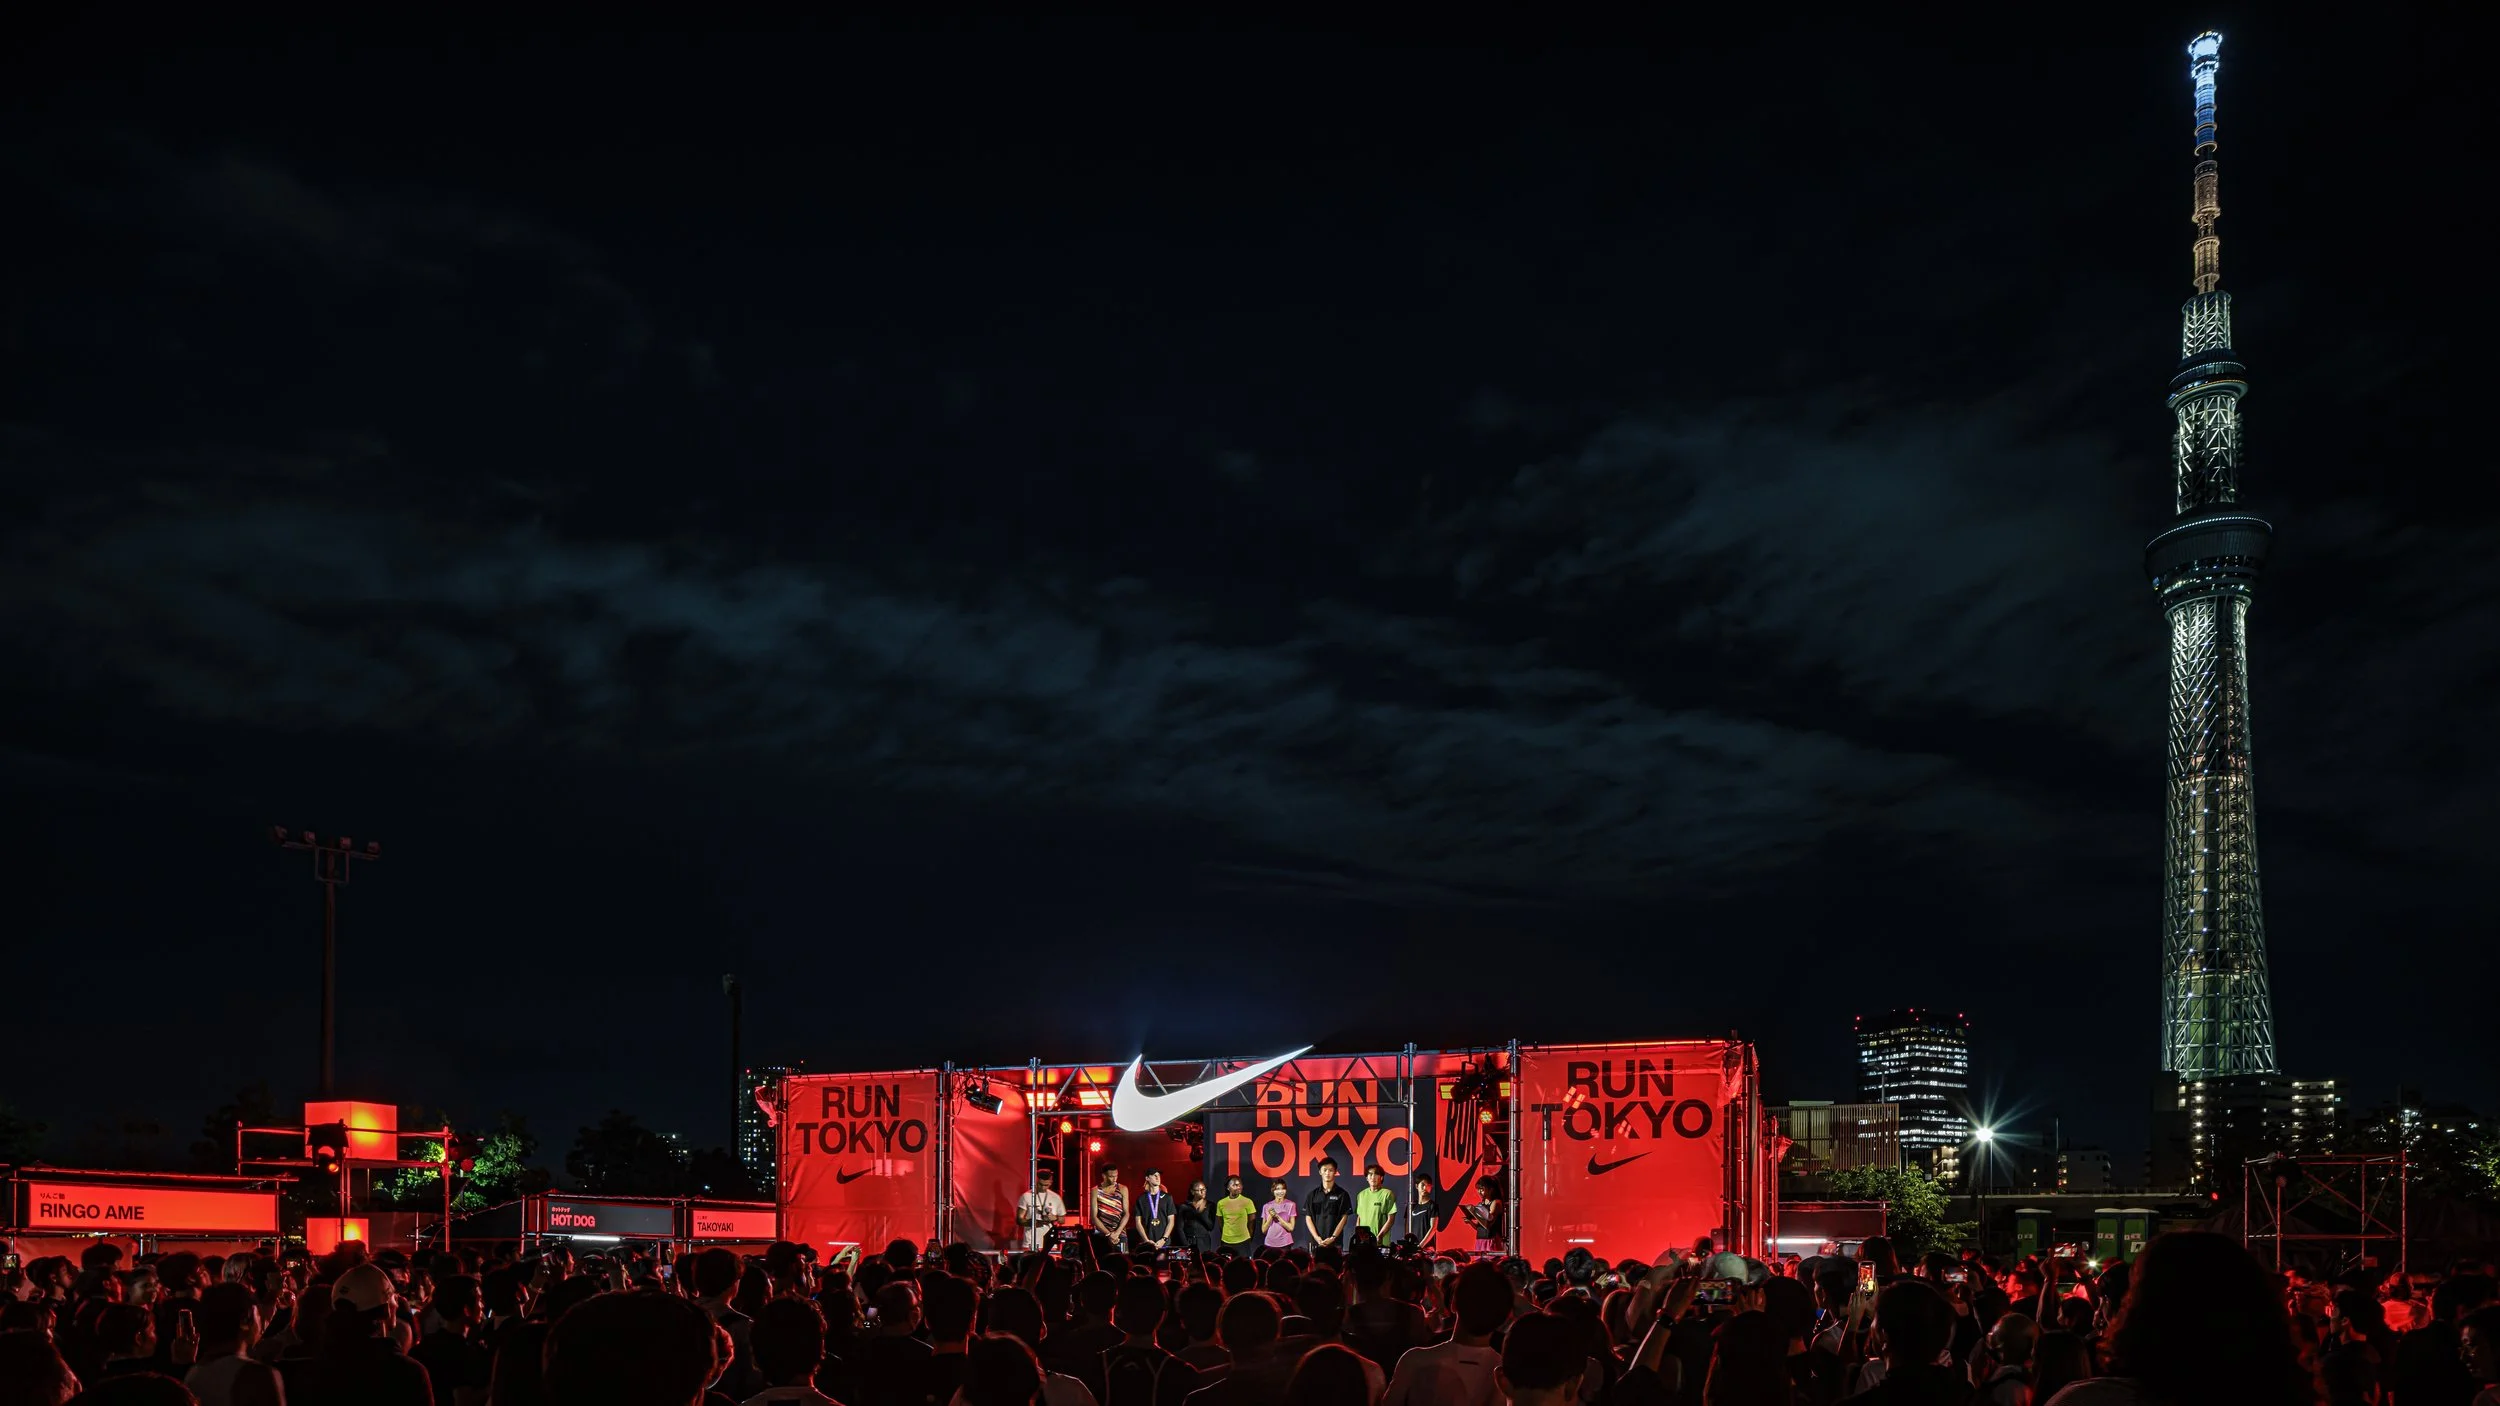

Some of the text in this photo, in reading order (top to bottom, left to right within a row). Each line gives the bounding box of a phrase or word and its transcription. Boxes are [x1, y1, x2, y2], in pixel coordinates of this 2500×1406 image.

[1567, 1058, 1674, 1099] RUN
[822, 1084, 899, 1119] RUN
[1256, 1081, 1378, 1127] RUN
[1531, 1099, 1713, 1141] TOKYO
[795, 1119, 928, 1155] TOKYO
[1443, 1099, 1479, 1164] RUN
[1215, 1127, 1424, 1179] TOKYO
[40, 1203, 145, 1220] RINGO AME
[551, 1214, 596, 1228] HOT DOG
[697, 1222, 734, 1232] TAKOYAKI
